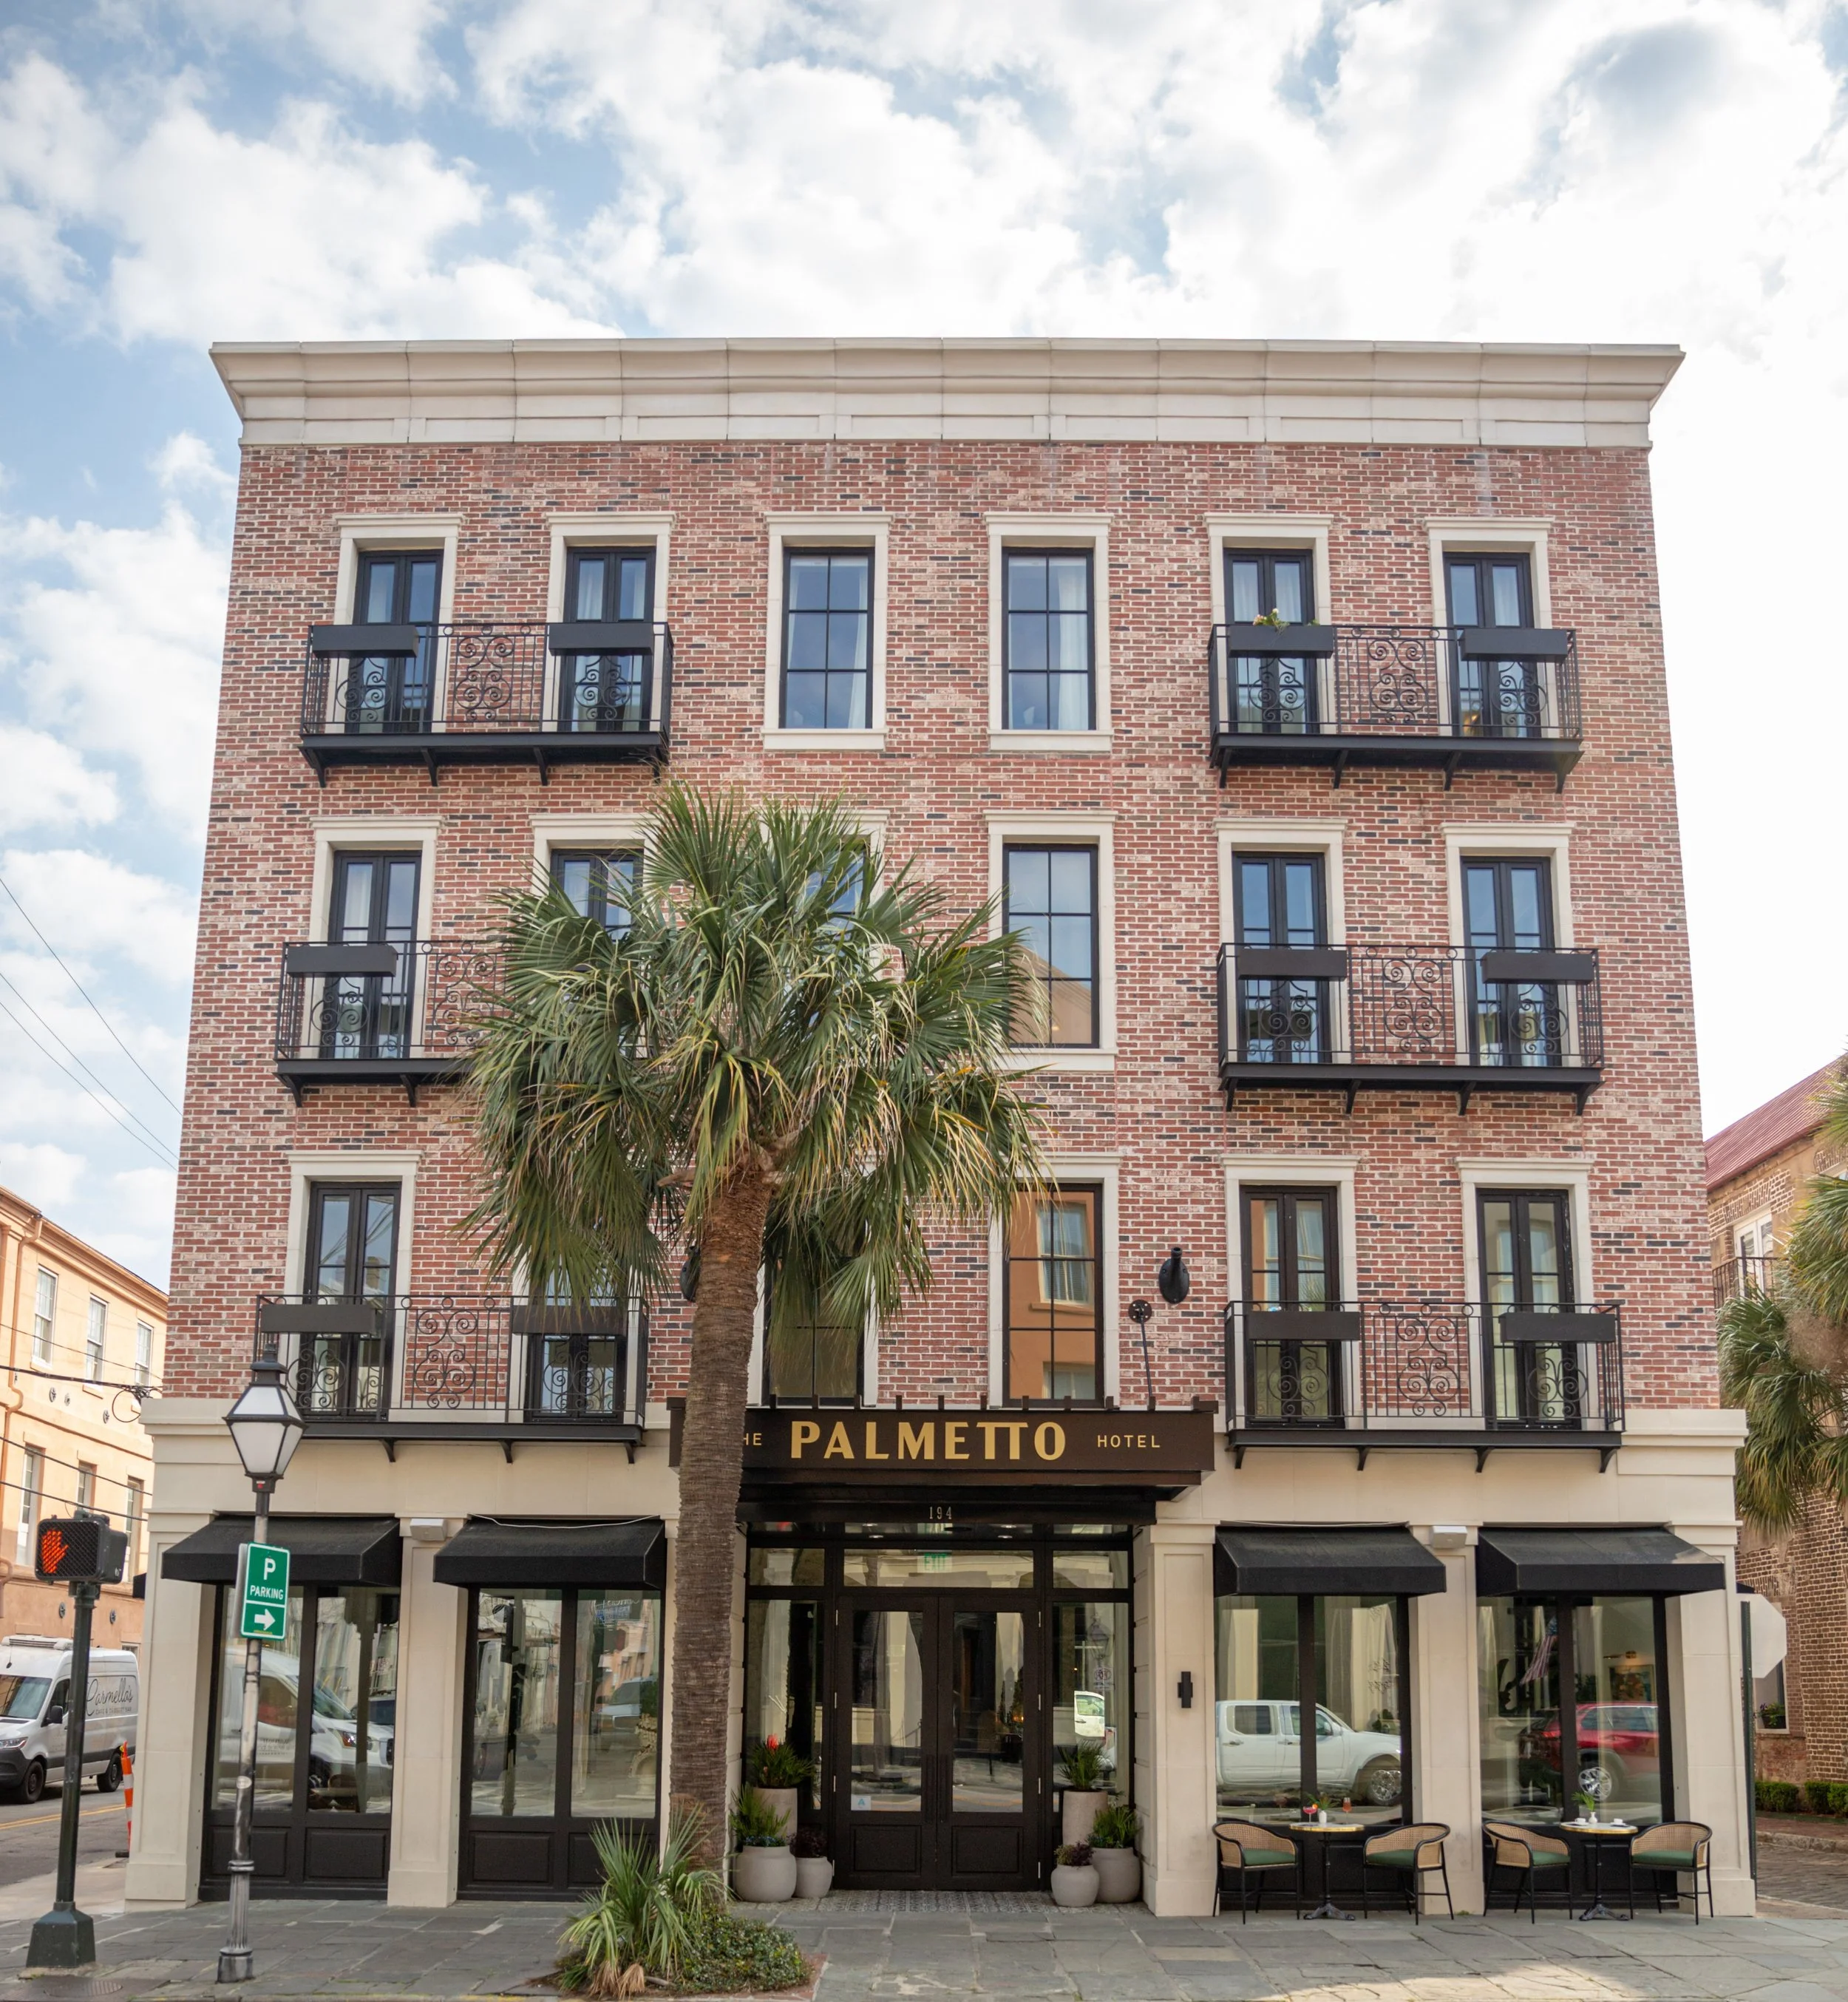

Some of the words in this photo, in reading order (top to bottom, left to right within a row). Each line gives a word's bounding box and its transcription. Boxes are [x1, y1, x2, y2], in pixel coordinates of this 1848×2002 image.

[743, 1433, 762, 1446] HE
[791, 1421, 1066, 1461] PALMETTO
[1097, 1435, 1161, 1448] HOTEL
[929, 1507, 952, 1519] 194
[263, 1558, 276, 1581] P
[250, 1585, 284, 1600] PARKING
